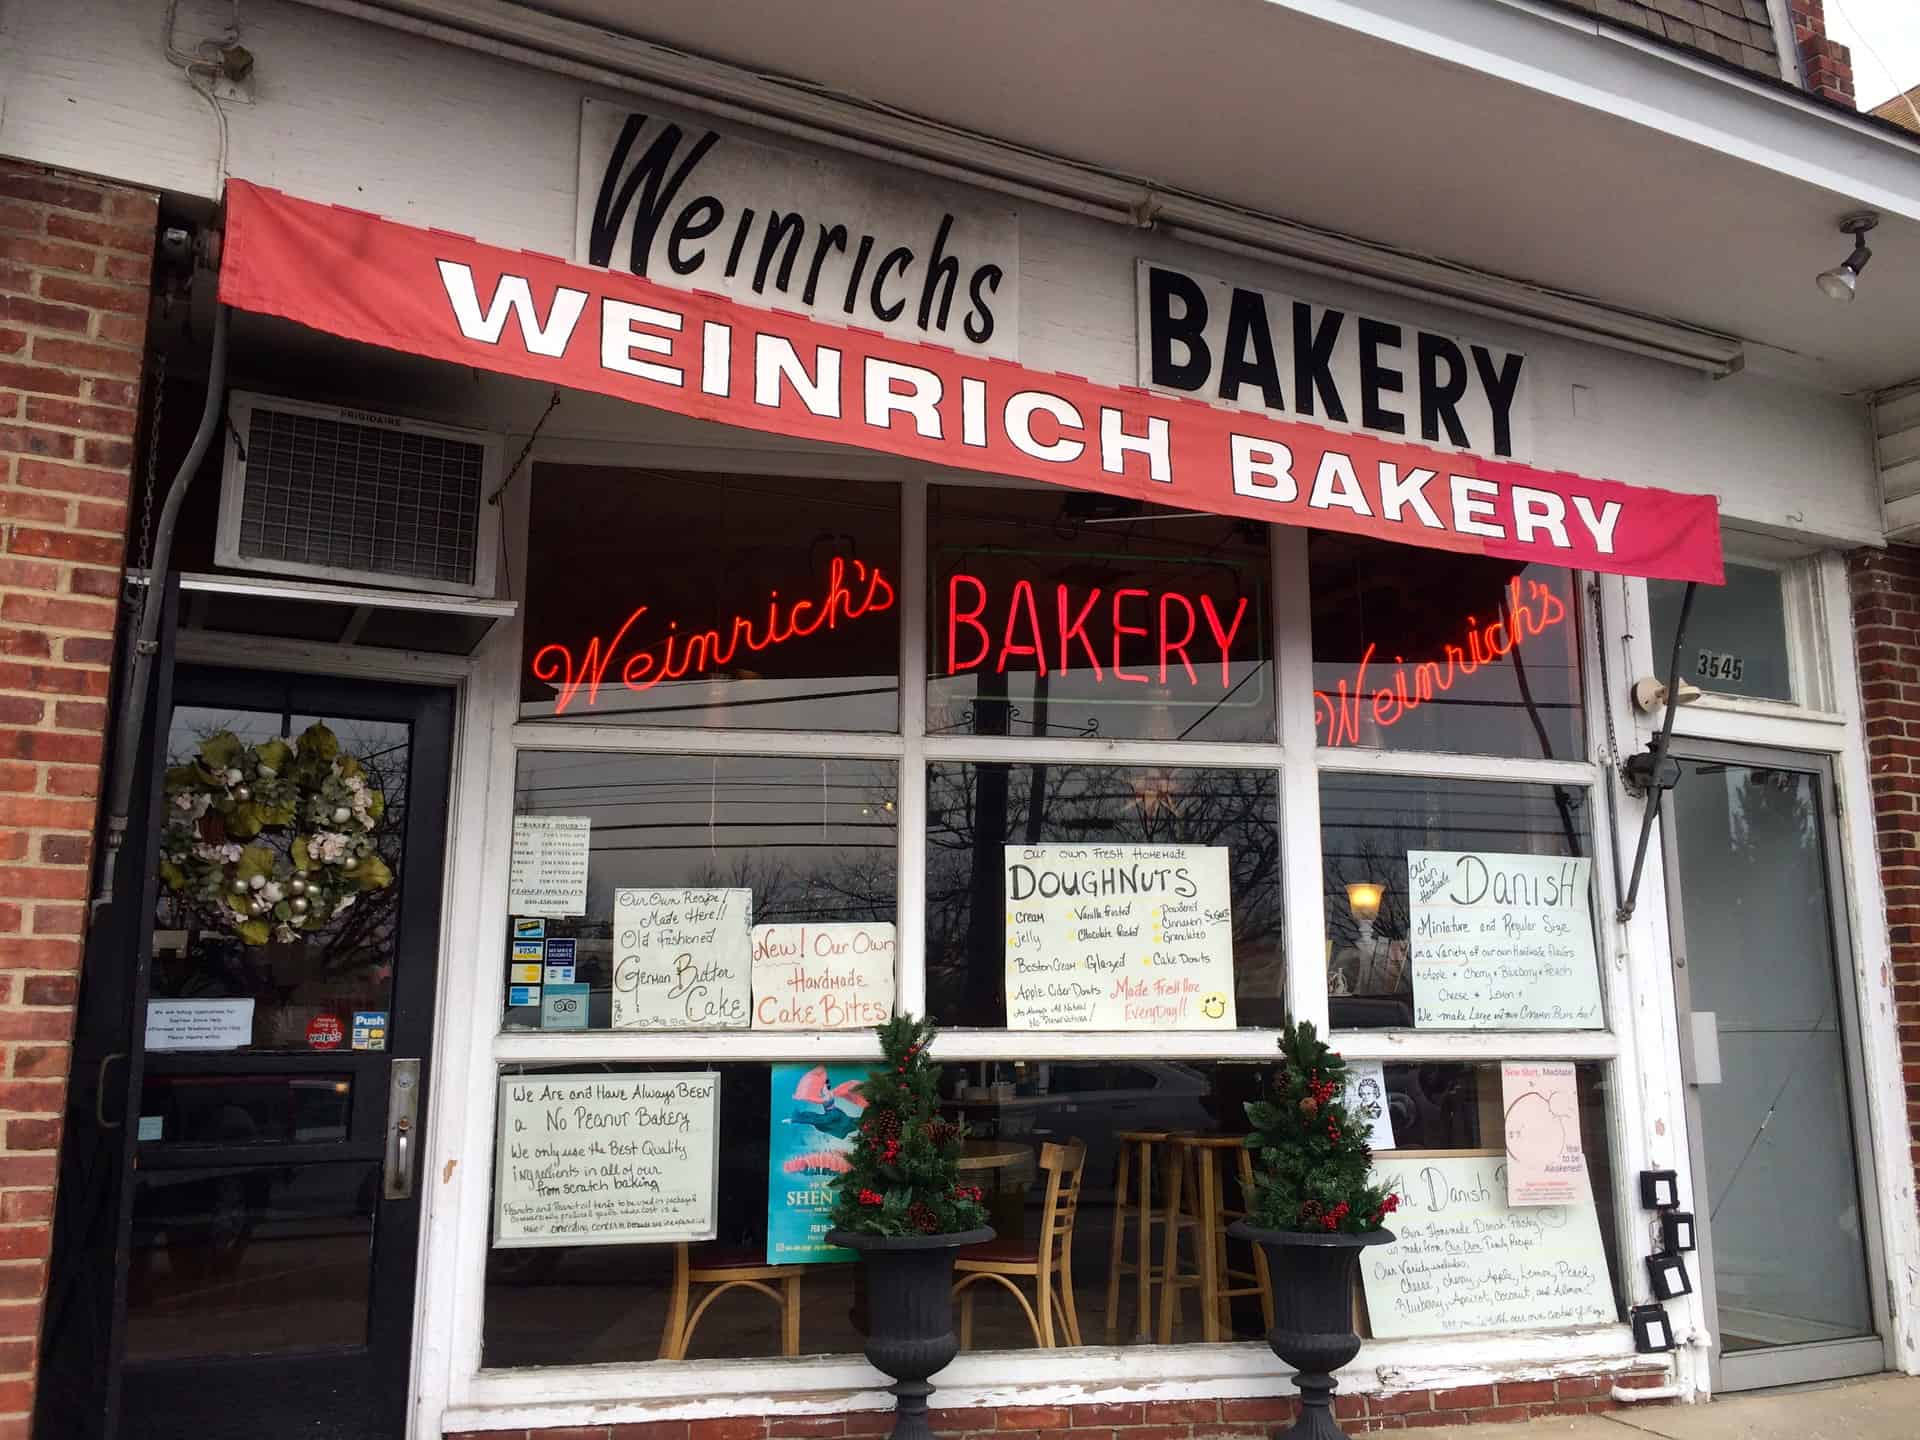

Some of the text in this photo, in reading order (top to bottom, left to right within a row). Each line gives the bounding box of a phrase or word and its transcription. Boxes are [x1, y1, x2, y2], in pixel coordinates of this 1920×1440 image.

[589, 114, 1002, 344] Weinrichs
[1149, 267, 1524, 457] BAKERY
[437, 259, 1624, 554] WEINRICH BAKERY
[534, 557, 894, 714] Weinrich's
[948, 575, 1247, 688] BAKERY
[1313, 576, 1565, 746] Weinrich's
[1698, 654, 1742, 680] 3545
[1008, 863, 1198, 900] DOUGHNUTS
[815, 933, 849, 956] Our
[853, 931, 896, 954] Own
[355, 1016, 384, 1025] Push
[685, 986, 745, 1022] Cake
[758, 995, 816, 1024] Cake
[513, 1086, 533, 1103] We
[569, 1085, 592, 1099] and
[597, 1084, 627, 1101] Have
[632, 1084, 676, 1104] Always
[515, 1119, 527, 1132] a
[546, 1107, 567, 1131] No
[512, 1143, 529, 1159] We
[786, 1191, 832, 1206] SHEN
[1420, 1166, 1490, 1212] Danish
